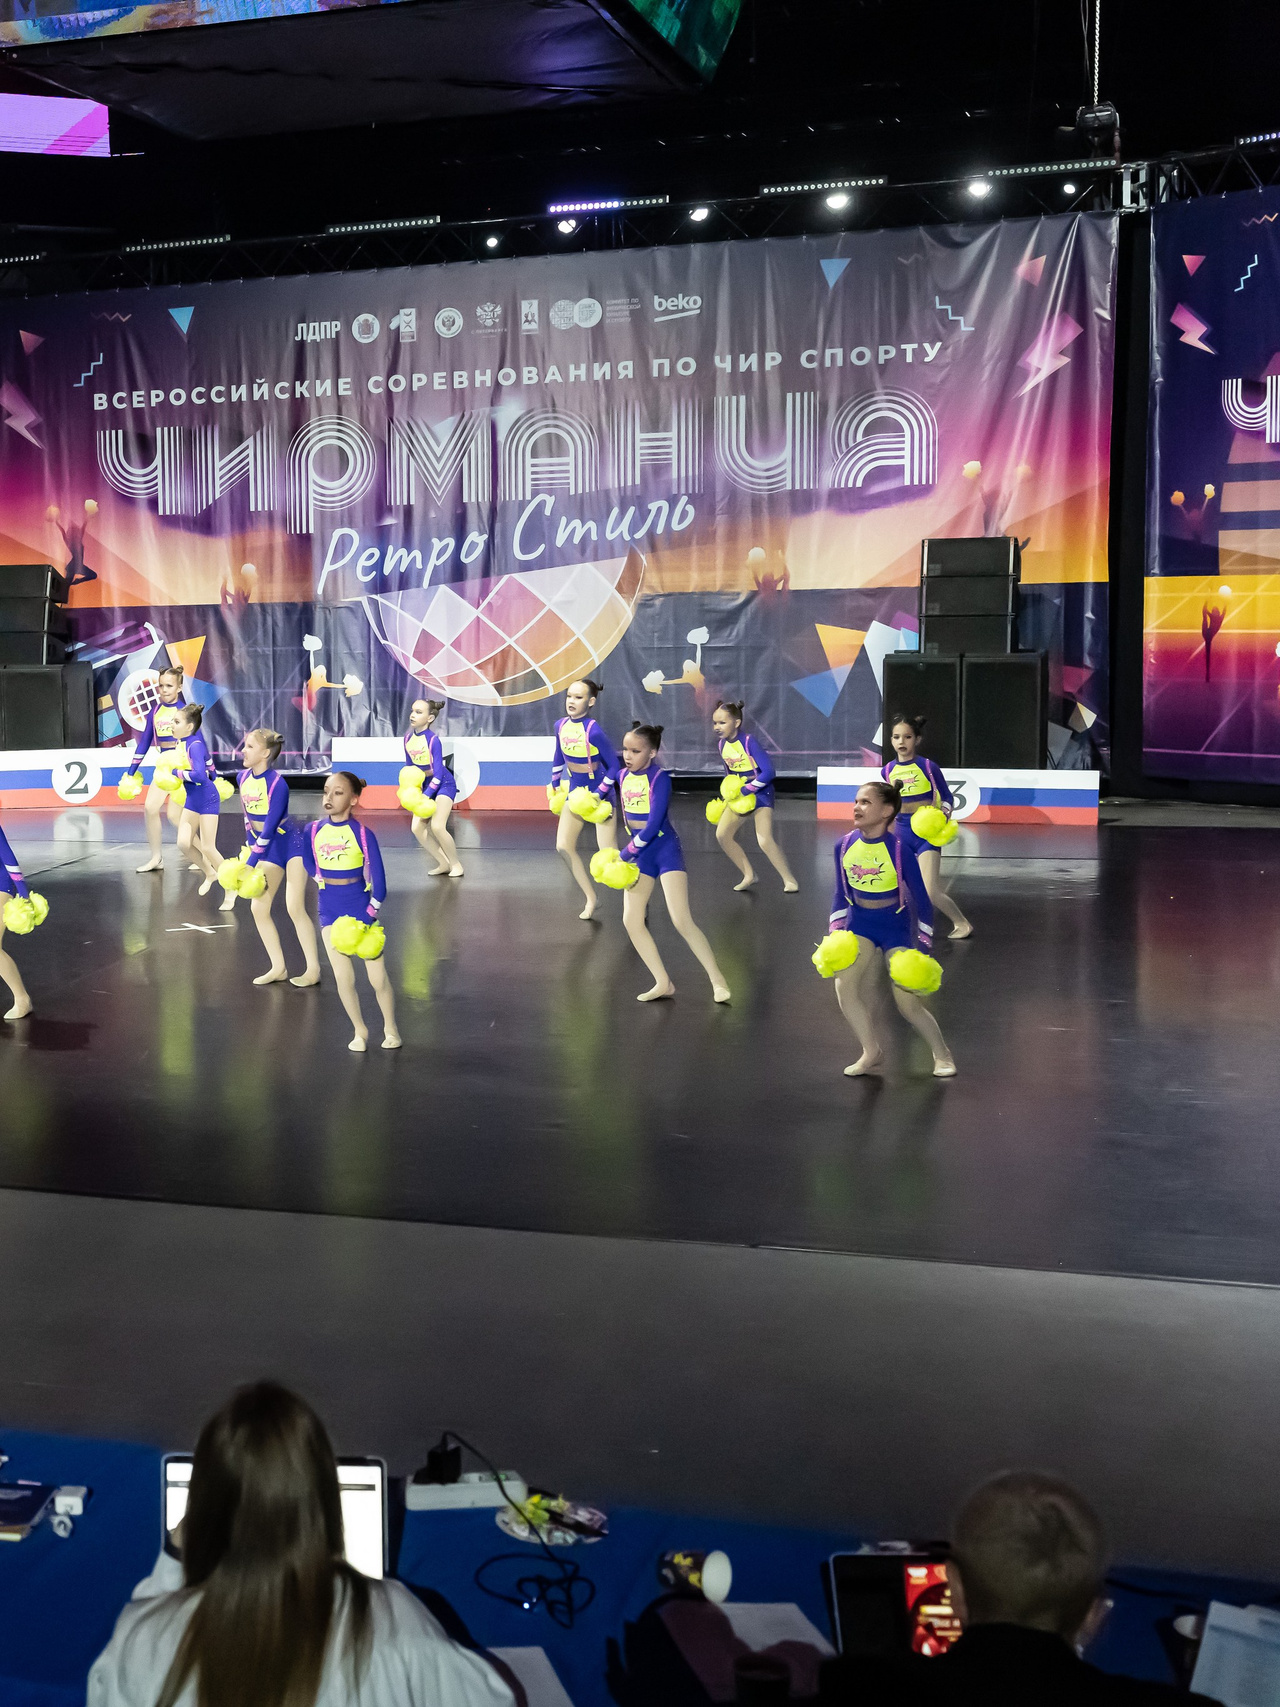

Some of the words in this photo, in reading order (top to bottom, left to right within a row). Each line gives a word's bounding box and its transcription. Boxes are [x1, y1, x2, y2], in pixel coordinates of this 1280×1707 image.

[653, 293, 702, 311] beko
[294, 321, 341, 342] ЛДПР
[94, 377, 352, 411] ВСЕРОССИЙСКИЕ
[368, 360, 634, 395] СОРЕВНОВАНИЯ
[652, 356, 697, 378] ПО
[714, 351, 783, 374] ЧИР
[800, 341, 943, 368] СПОРТУ
[317, 526, 488, 595] Ретро
[512, 494, 696, 562] Стиль
[64, 761, 89, 794] 2
